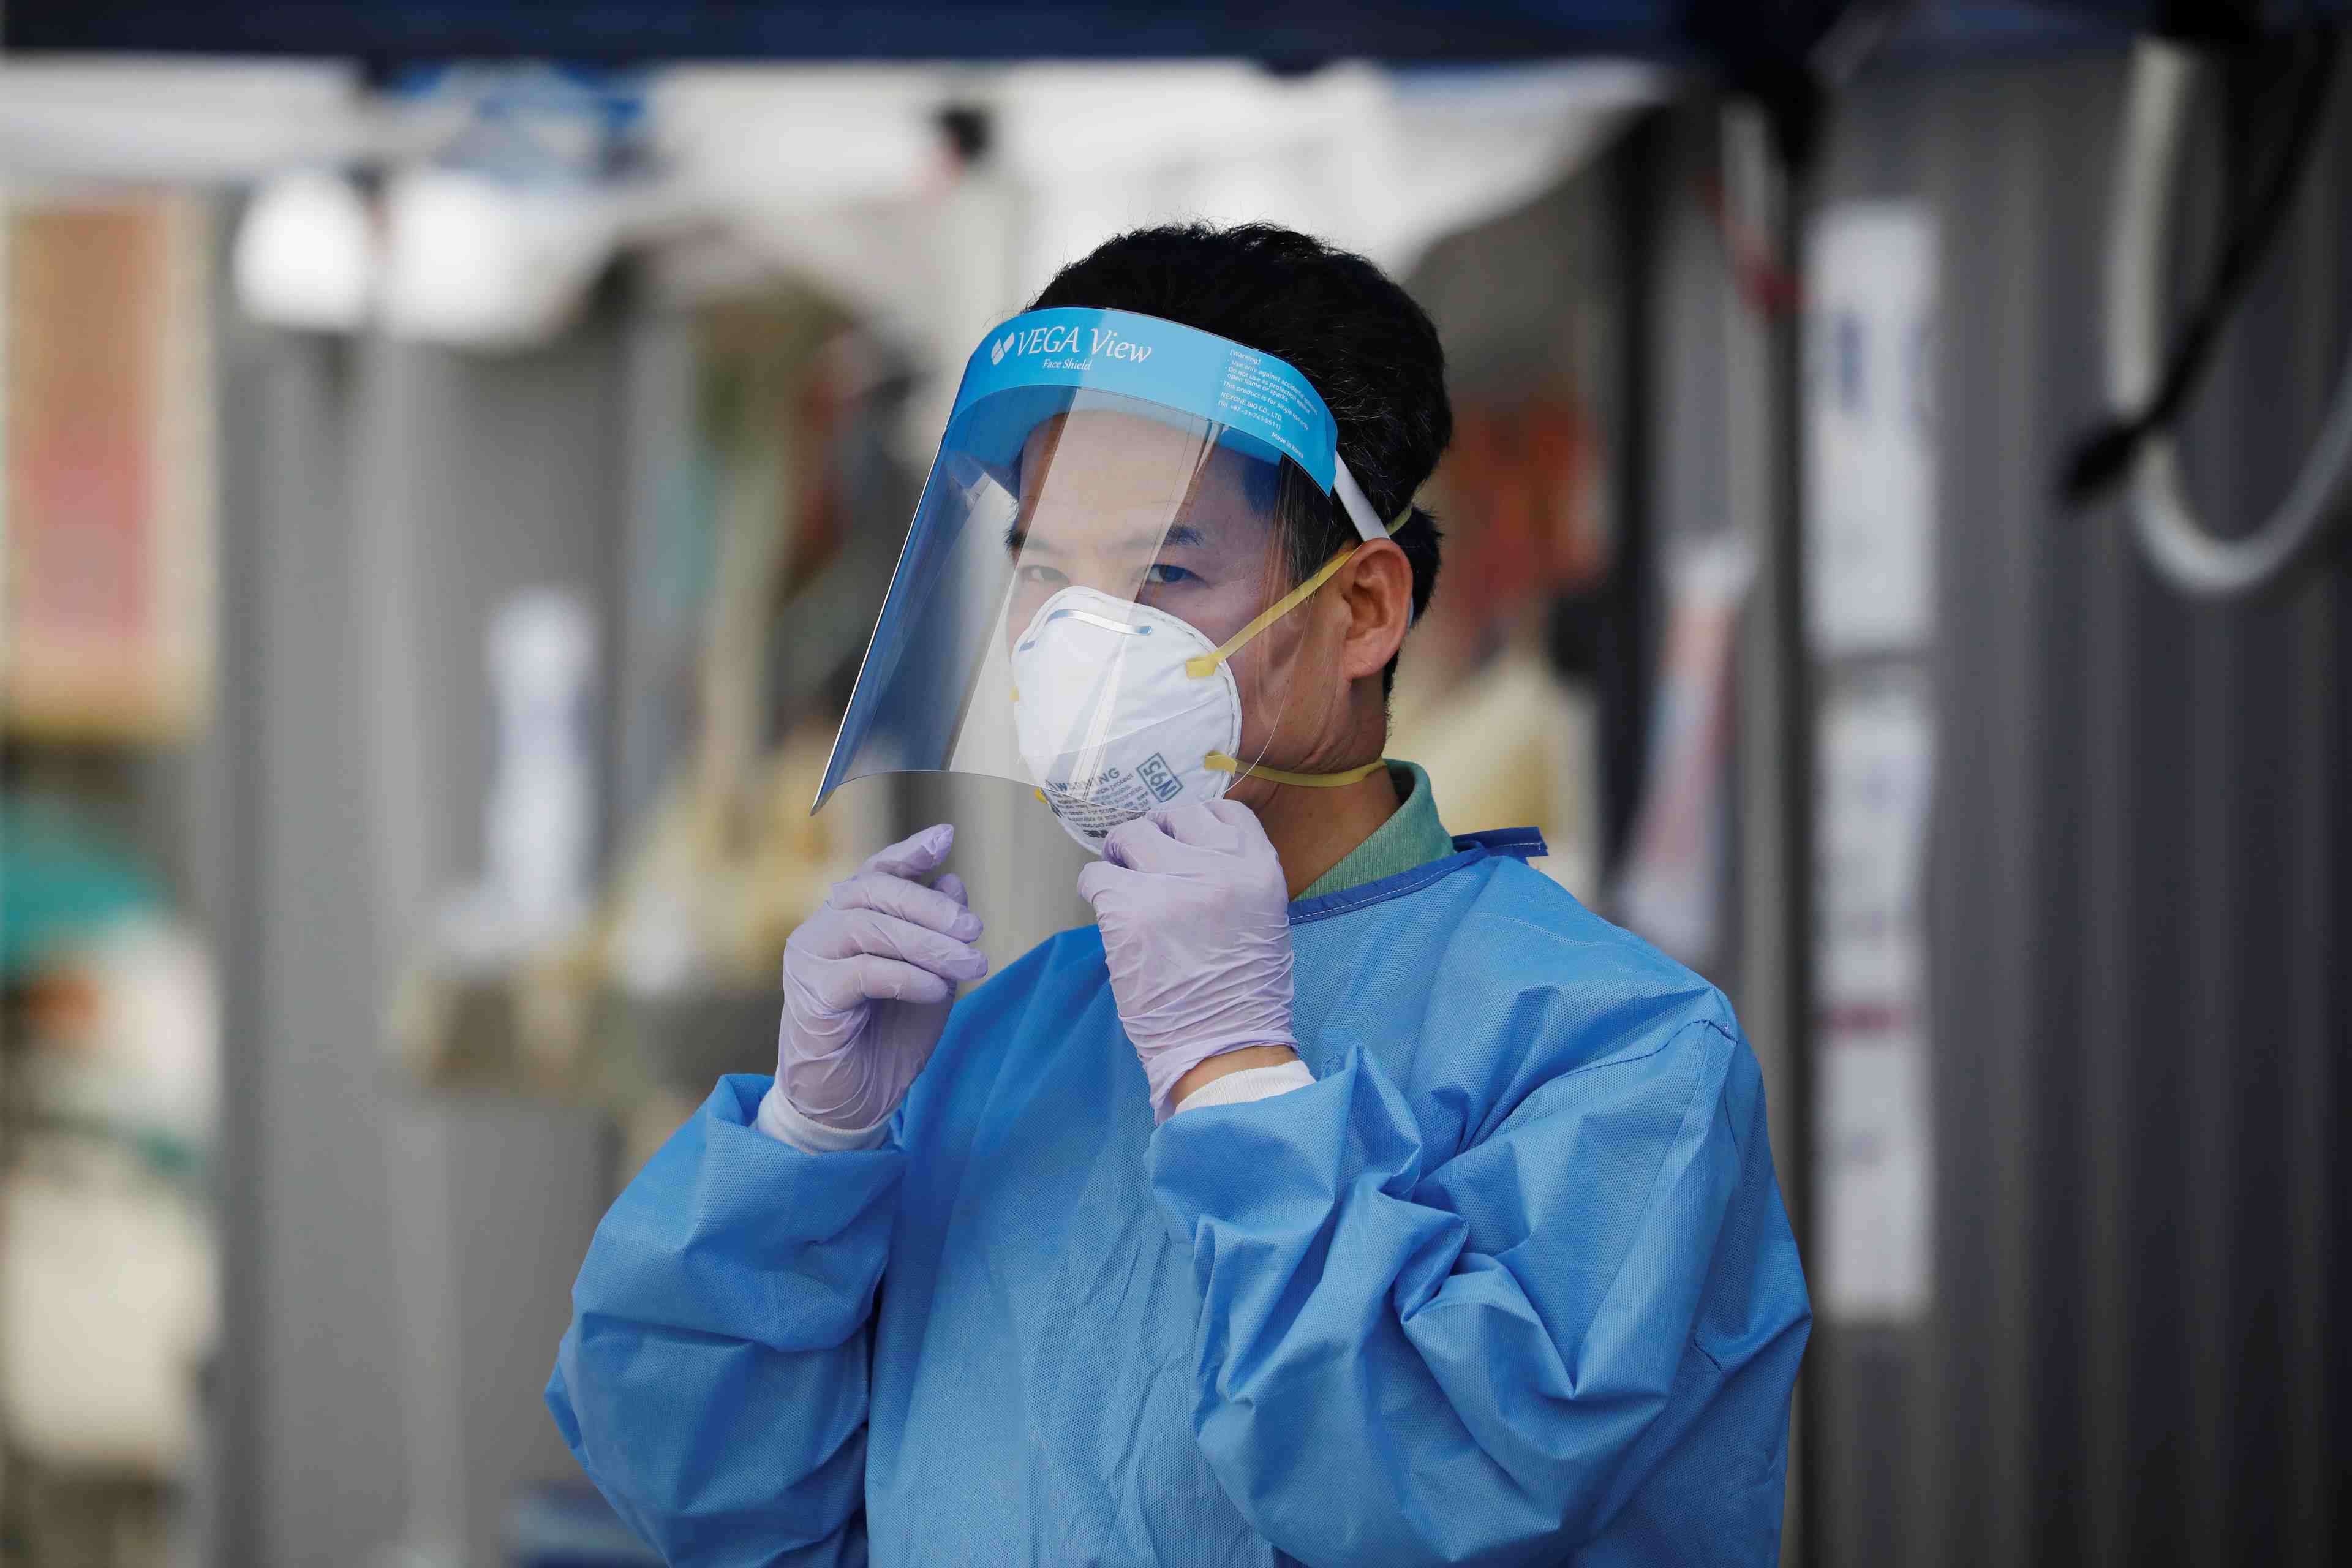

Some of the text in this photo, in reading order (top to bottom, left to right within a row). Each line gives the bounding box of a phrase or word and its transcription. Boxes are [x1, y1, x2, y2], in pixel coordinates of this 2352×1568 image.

[1017, 326, 1152, 363] VEGA View
[1043, 357, 1093, 371] Face Shield
[1227, 373, 1243, 383] open
[1244, 378, 1261, 389] flame
[1238, 369, 1249, 378] not
[1250, 373, 1261, 382] use
[1259, 370, 1280, 383] against
[1223, 380, 1235, 389] This
[1236, 385, 1260, 398] product
[1267, 397, 1276, 405] for
[1246, 401, 1258, 410] BIO
[1271, 432, 1286, 445] Made
[1291, 444, 1304, 459] Korea
[1142, 761, 1177, 797] N95
